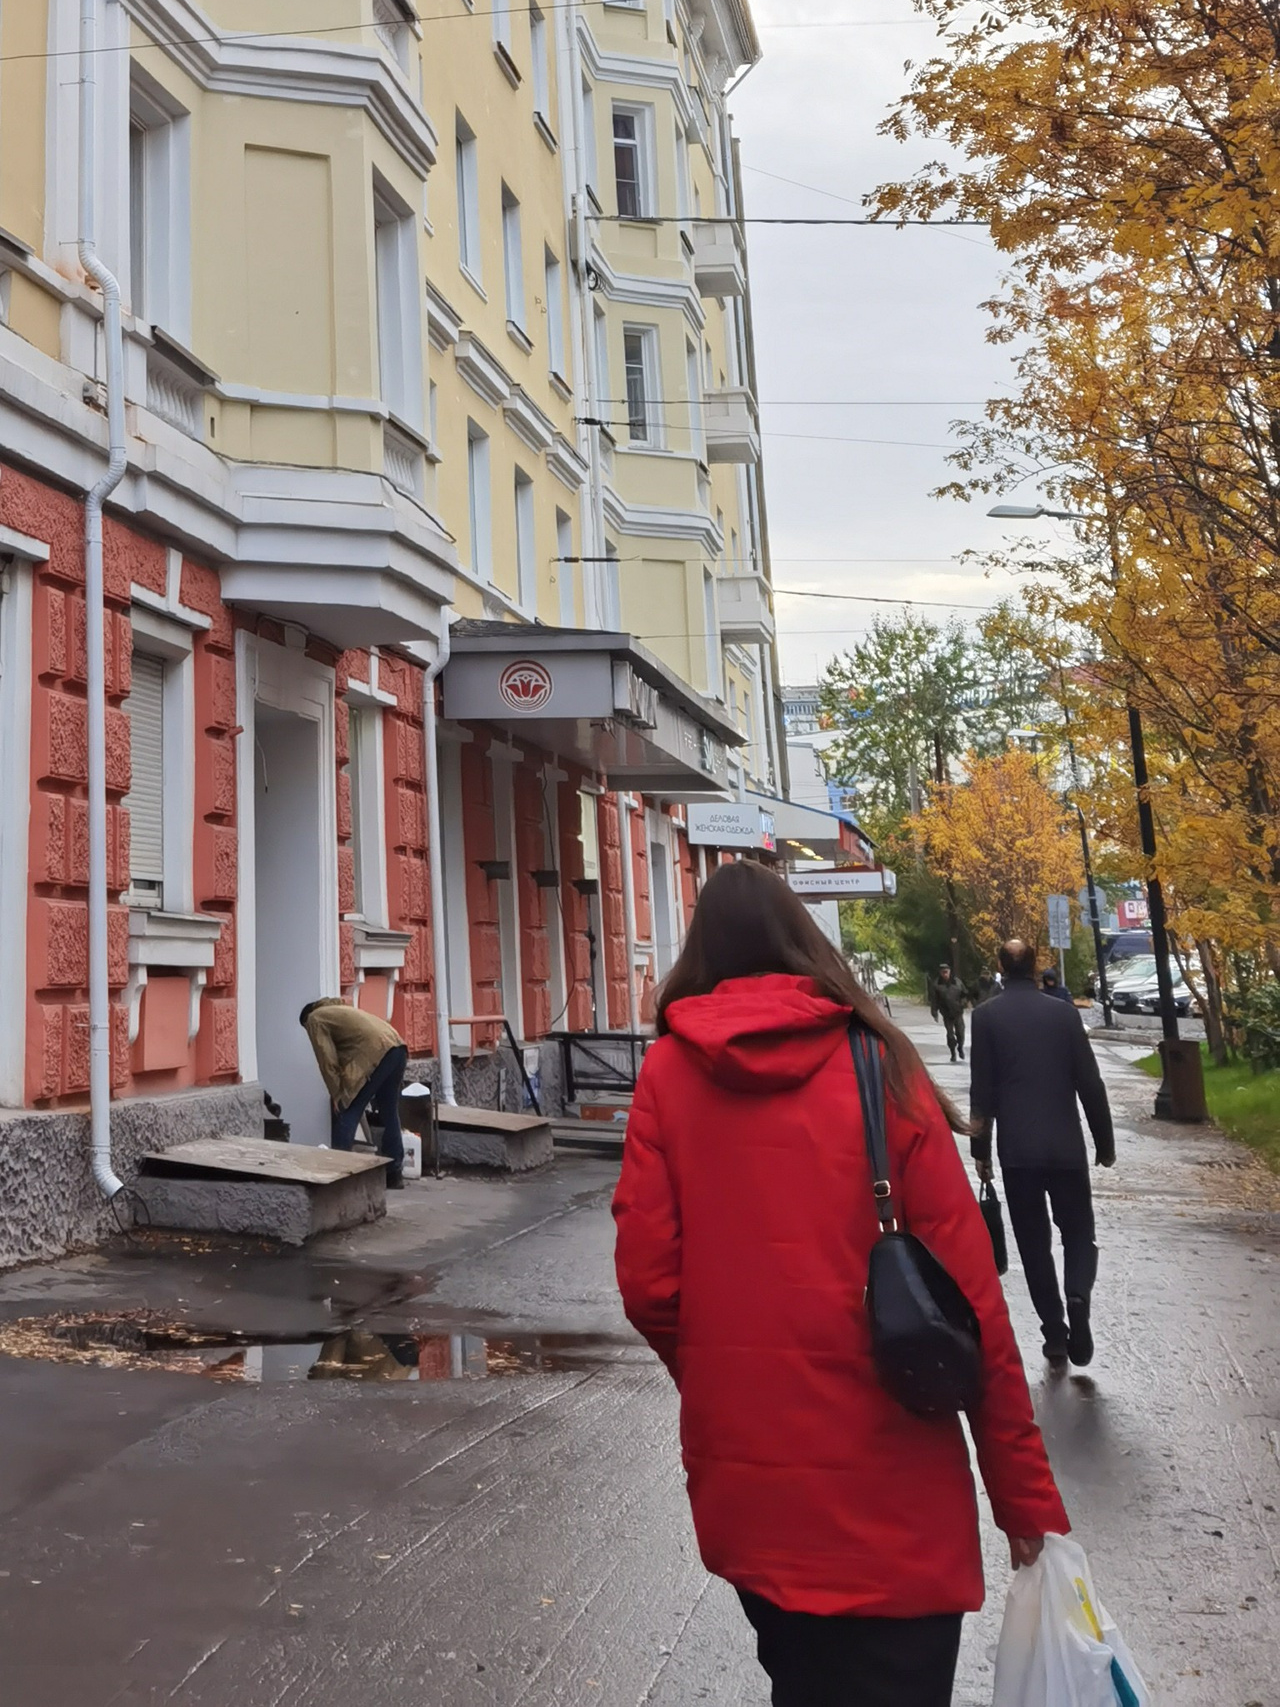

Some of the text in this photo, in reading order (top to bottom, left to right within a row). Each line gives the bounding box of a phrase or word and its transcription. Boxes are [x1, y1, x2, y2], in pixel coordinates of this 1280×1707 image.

[709, 814, 740, 824] ДЕЛОВАЯ
[695, 823, 755, 835] ЖЕНСКАЯ ОДЕЖДА
[834, 878, 860, 886] ЦЕНТР
